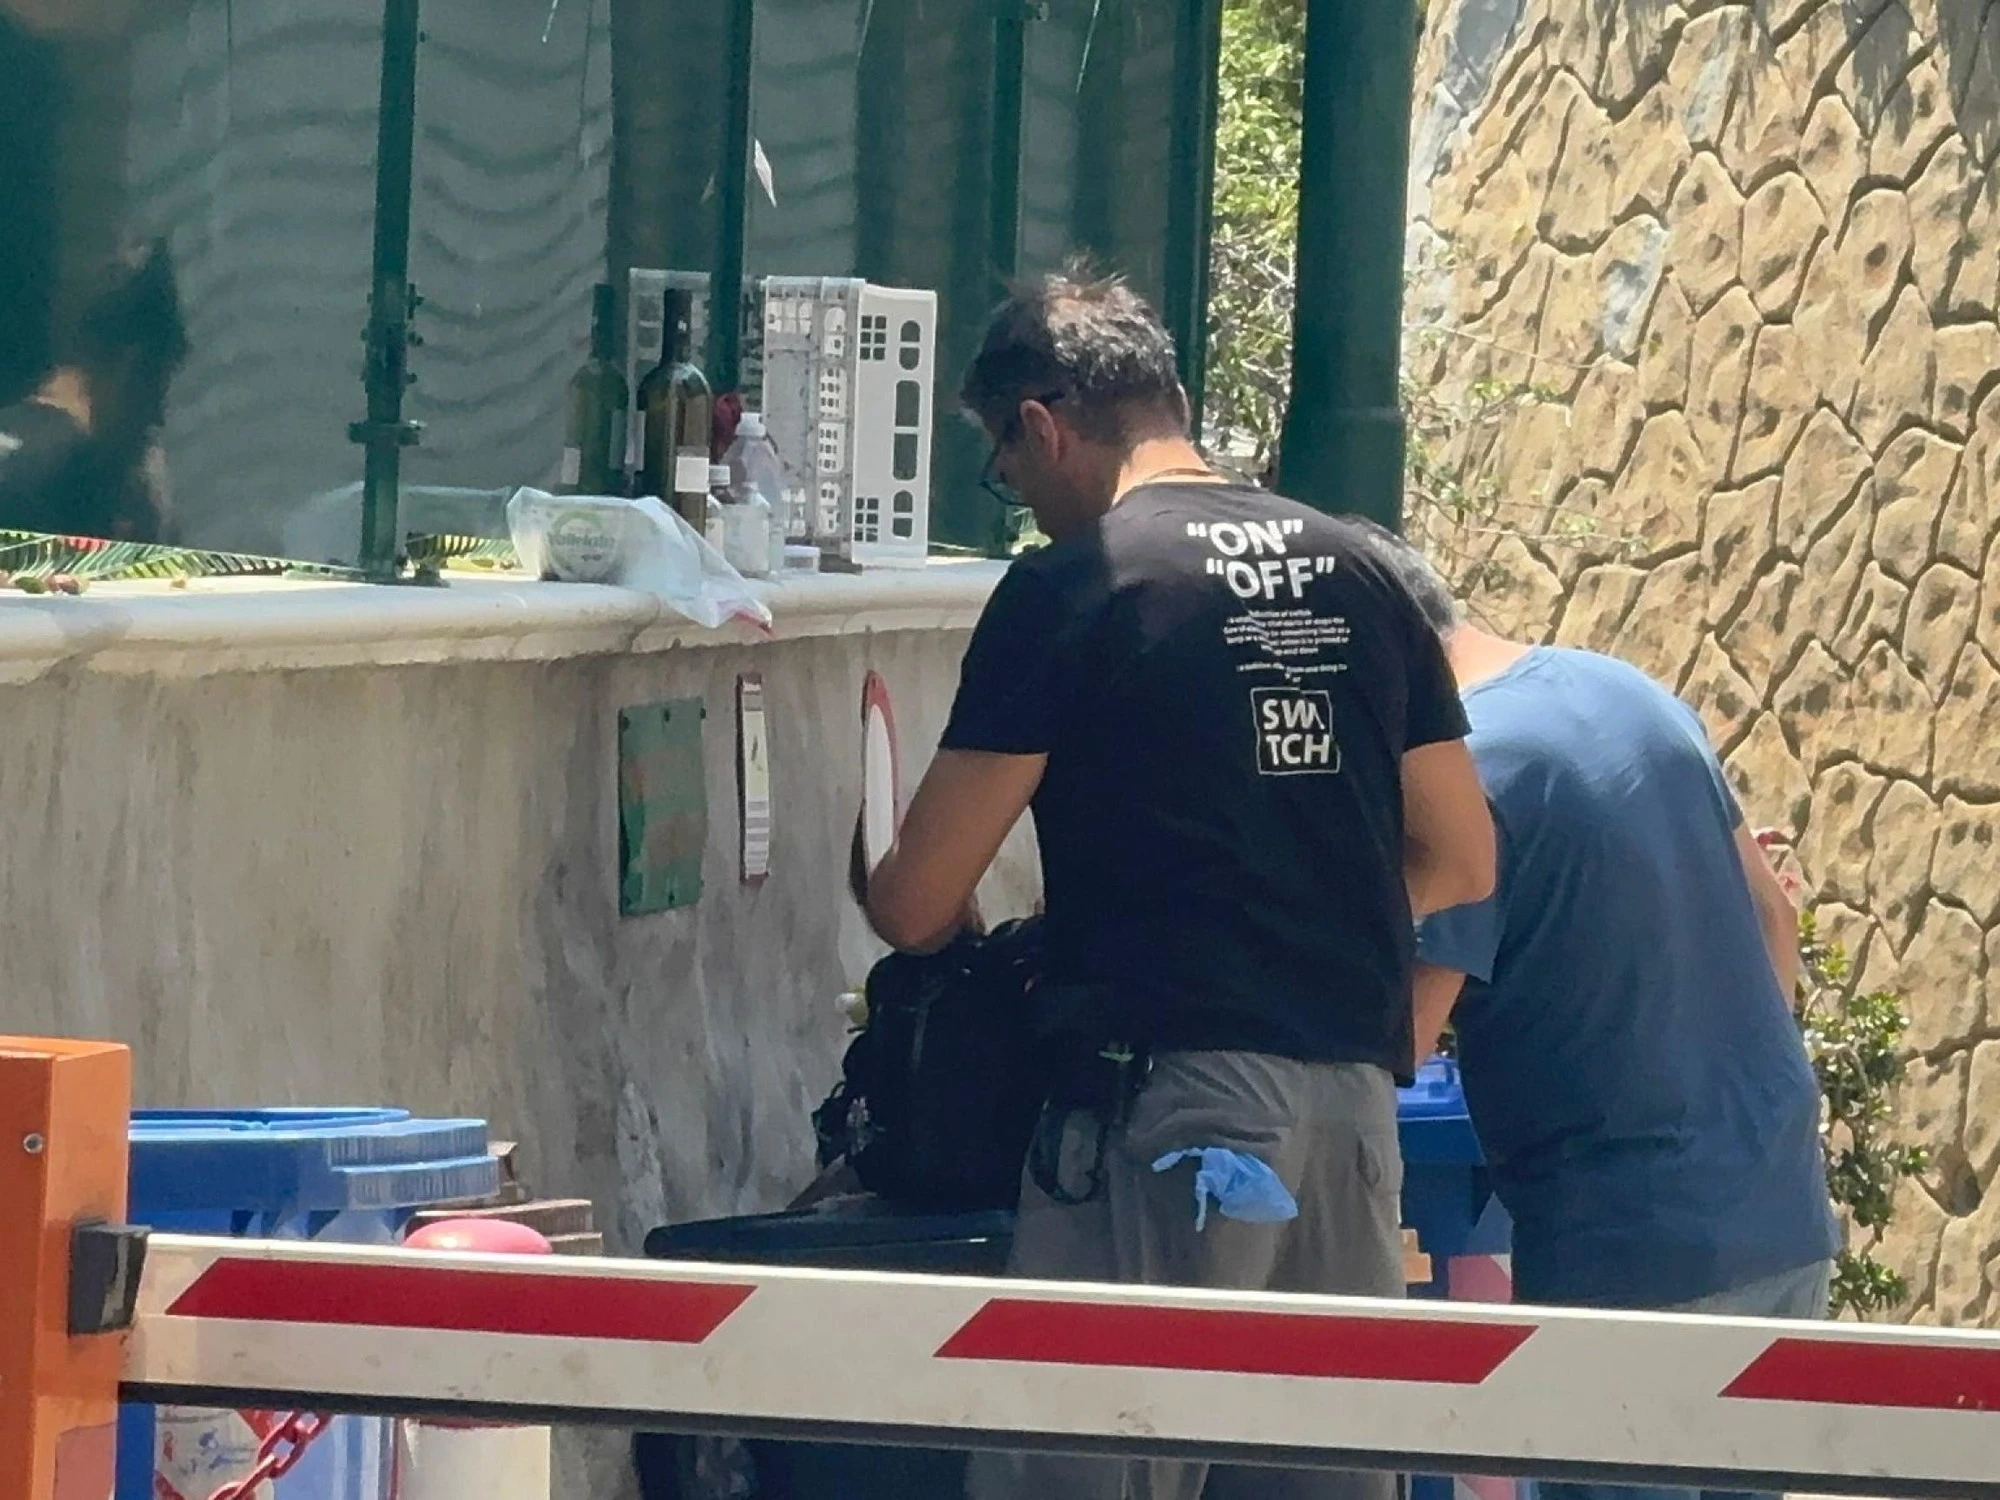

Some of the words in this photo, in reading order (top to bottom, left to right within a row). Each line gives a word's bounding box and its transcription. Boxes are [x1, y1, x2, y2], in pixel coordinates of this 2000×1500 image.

[1187, 519, 1304, 556] "ON"
[1206, 556, 1336, 600] "OFF"
[1266, 733, 1330, 765] TCH
